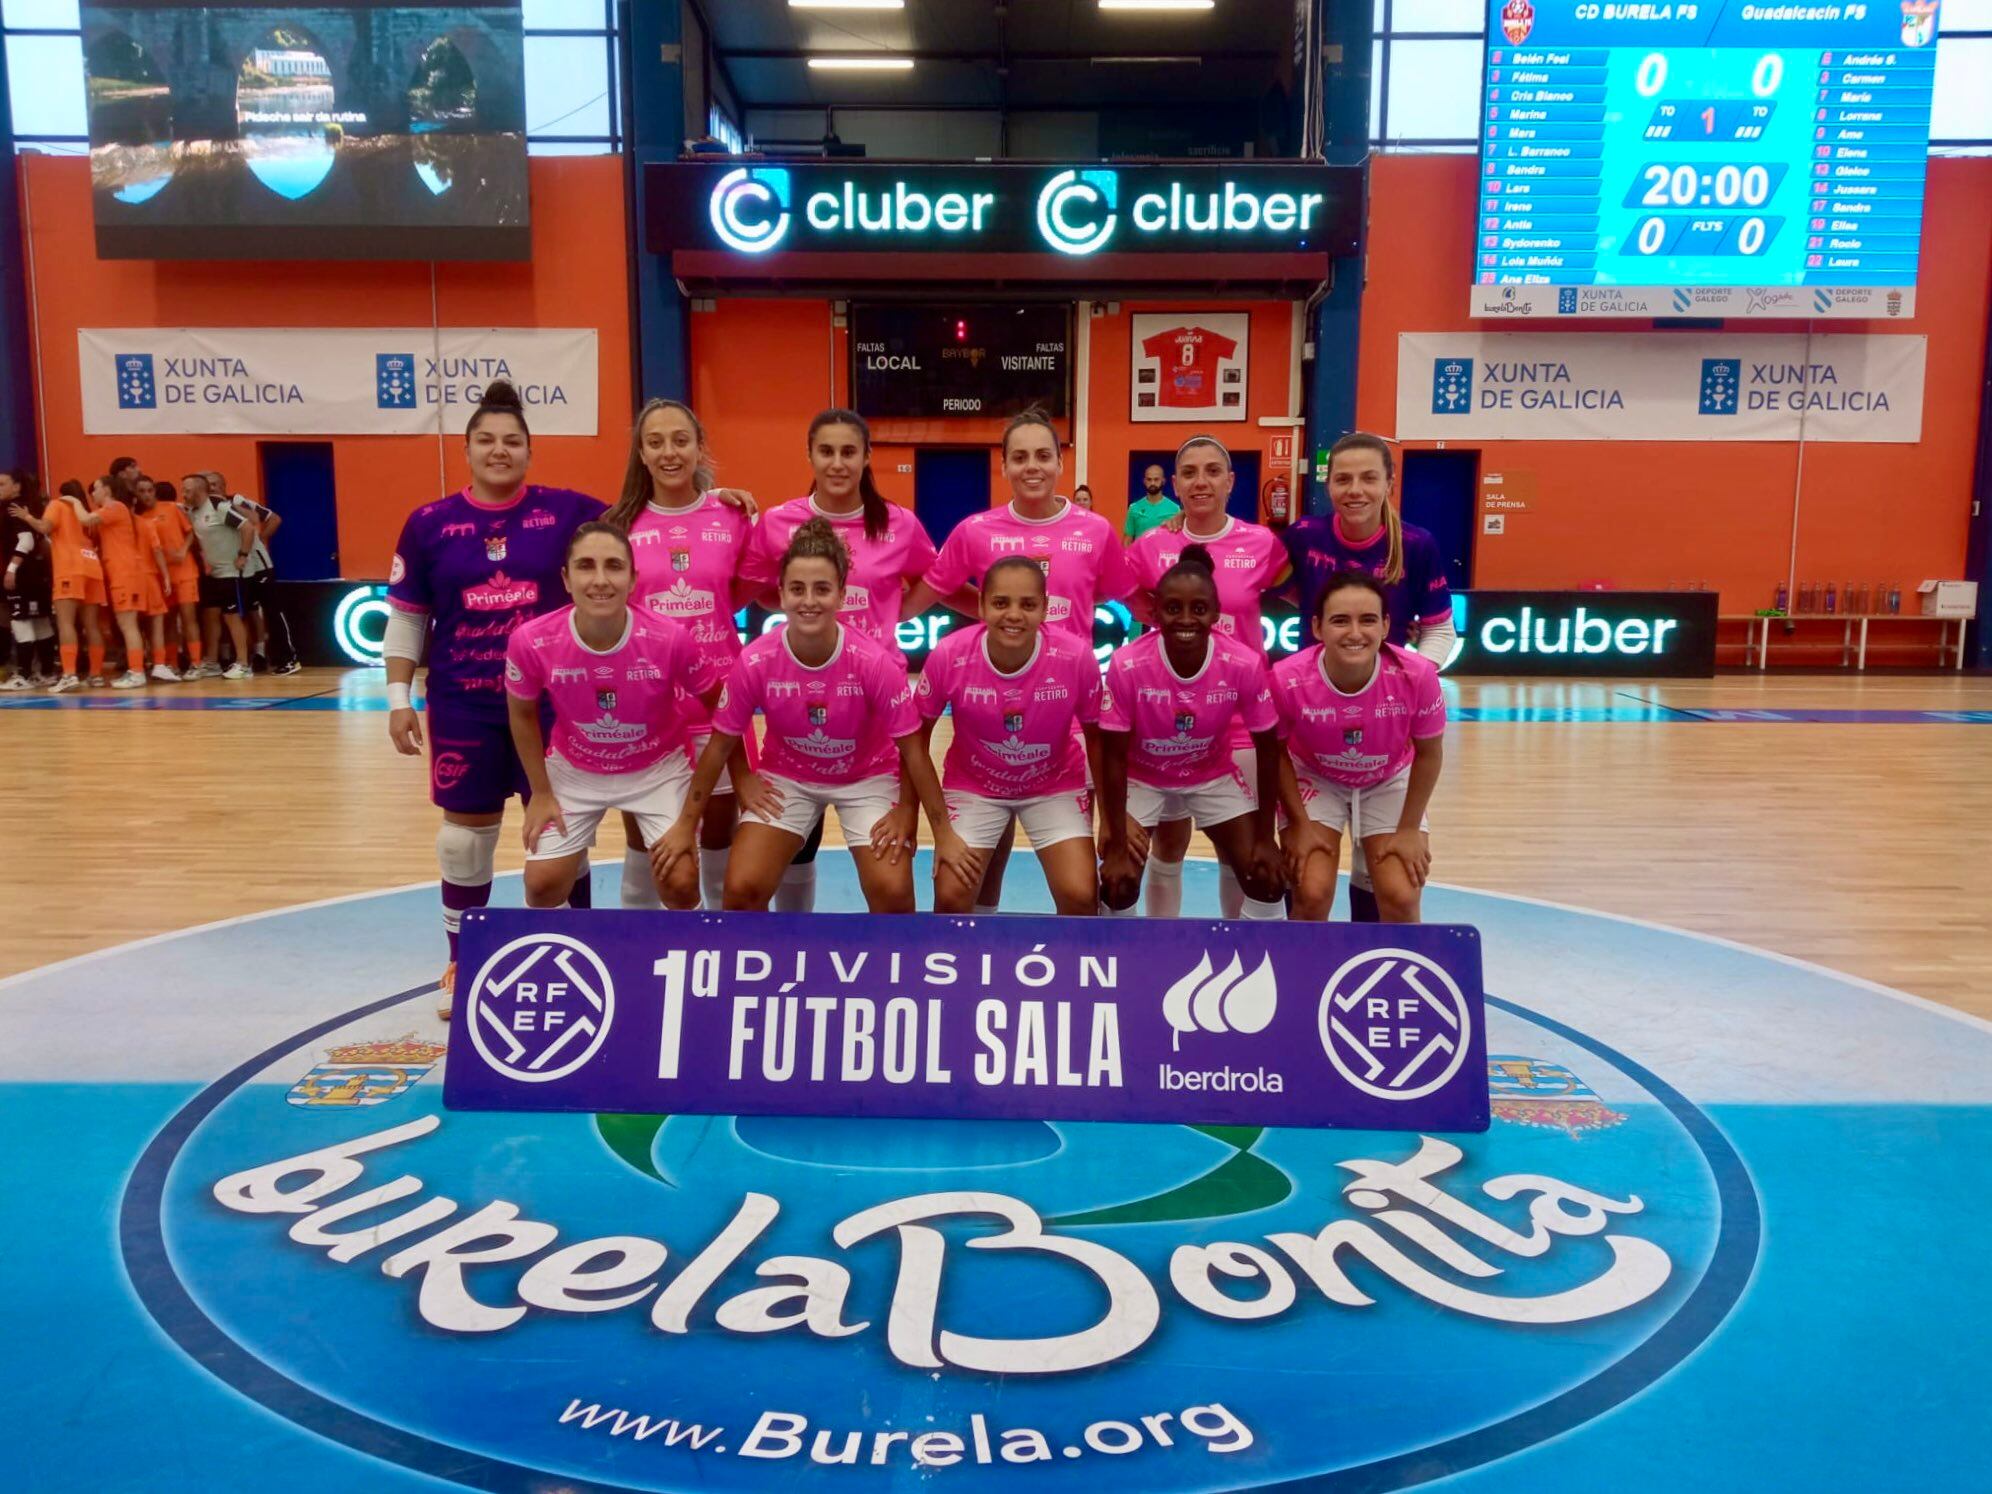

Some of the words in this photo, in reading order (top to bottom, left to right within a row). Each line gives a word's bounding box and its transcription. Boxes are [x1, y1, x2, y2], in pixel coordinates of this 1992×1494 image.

[1575, 4, 1600, 20] CD
[1603, 4, 1671, 20] BURELA
[1676, 5, 1698, 20] FS
[1843, 4, 1867, 20] FS
[1636, 52, 1668, 97] 0
[1751, 52, 1784, 98] 0
[1842, 73, 1886, 84] Carmen
[1511, 91, 1533, 101] Cris
[1819, 89, 1828, 101] 7
[332, 112, 366, 122] rutina
[1510, 109, 1547, 120] Marina
[1660, 105, 1676, 116] TO
[1753, 106, 1769, 117] TO
[1701, 106, 1715, 134] 1
[1488, 144, 1497, 156] 7
[1508, 146, 1517, 156] L.
[1521, 146, 1570, 157] Barranco
[1507, 164, 1545, 175] Sandra
[1506, 184, 1530, 193] Lara
[1642, 164, 1769, 206] 20:00
[806, 181, 993, 231] cluber
[1132, 181, 1323, 231] cluber
[1487, 200, 1499, 211] 11
[1504, 202, 1532, 211] Irene
[1832, 202, 1872, 213] Sandra
[1692, 221, 1724, 231] FLTS
[1638, 216, 1666, 255] 0
[1738, 217, 1766, 255] 0
[1502, 238, 1560, 249] Sydorenko
[1806, 254, 1823, 268] 22
[1500, 274, 1522, 284] Ana
[1581, 289, 1623, 300] XUNTA
[1695, 288, 1733, 296] DEPORTE
[1836, 288, 1873, 296] DEPORTE
[1580, 301, 1595, 312] DE
[1600, 301, 1649, 312] GALICIA
[1836, 296, 1869, 304] GALEGO
[857, 343, 885, 352] FALTAS
[1036, 343, 1064, 352] FALTAS
[1182, 344, 1194, 366] 8
[164, 358, 249, 378] XUNTA
[425, 358, 512, 378] XUNTA
[867, 356, 922, 370] LOCAL
[1001, 356, 1055, 370] VISITANTE
[1483, 363, 1571, 383] XUNTA
[1751, 364, 1838, 384] XUNTA
[165, 384, 196, 404] DE
[203, 384, 305, 404] GALICIA
[425, 384, 458, 404] DE
[464, 384, 568, 405] GICIA
[1481, 390, 1514, 409] DE
[1520, 390, 1624, 410] GALICIA
[1748, 391, 1780, 410] DE
[1788, 391, 1890, 411] GALICIA
[944, 399, 981, 410] PERIODO
[523, 516, 556, 529] RETIRO
[701, 532, 732, 544] RETIRO
[1062, 540, 1093, 552] RETIRO
[1224, 558, 1257, 569] RETIRO
[650, 598, 714, 612] Priméale
[1481, 607, 1678, 654] cluber
[626, 668, 662, 682] RETIRO
[1034, 688, 1068, 702] RETIRO
[1206, 690, 1239, 704] RETIRO
[516, 983, 569, 1003] RF
[652, 949, 721, 1080] 1ª
[735, 944, 1118, 988] DIVISIÓN
[1367, 998, 1420, 1019] RF
[513, 1011, 566, 1031] EF
[728, 982, 951, 1084] FÚTBOL
[975, 999, 1123, 1088] SALA
[1368, 1028, 1421, 1048] EF
[1159, 1063, 1284, 1093] Iberdrola
[559, 1398, 1256, 1467] www.Burela.org
